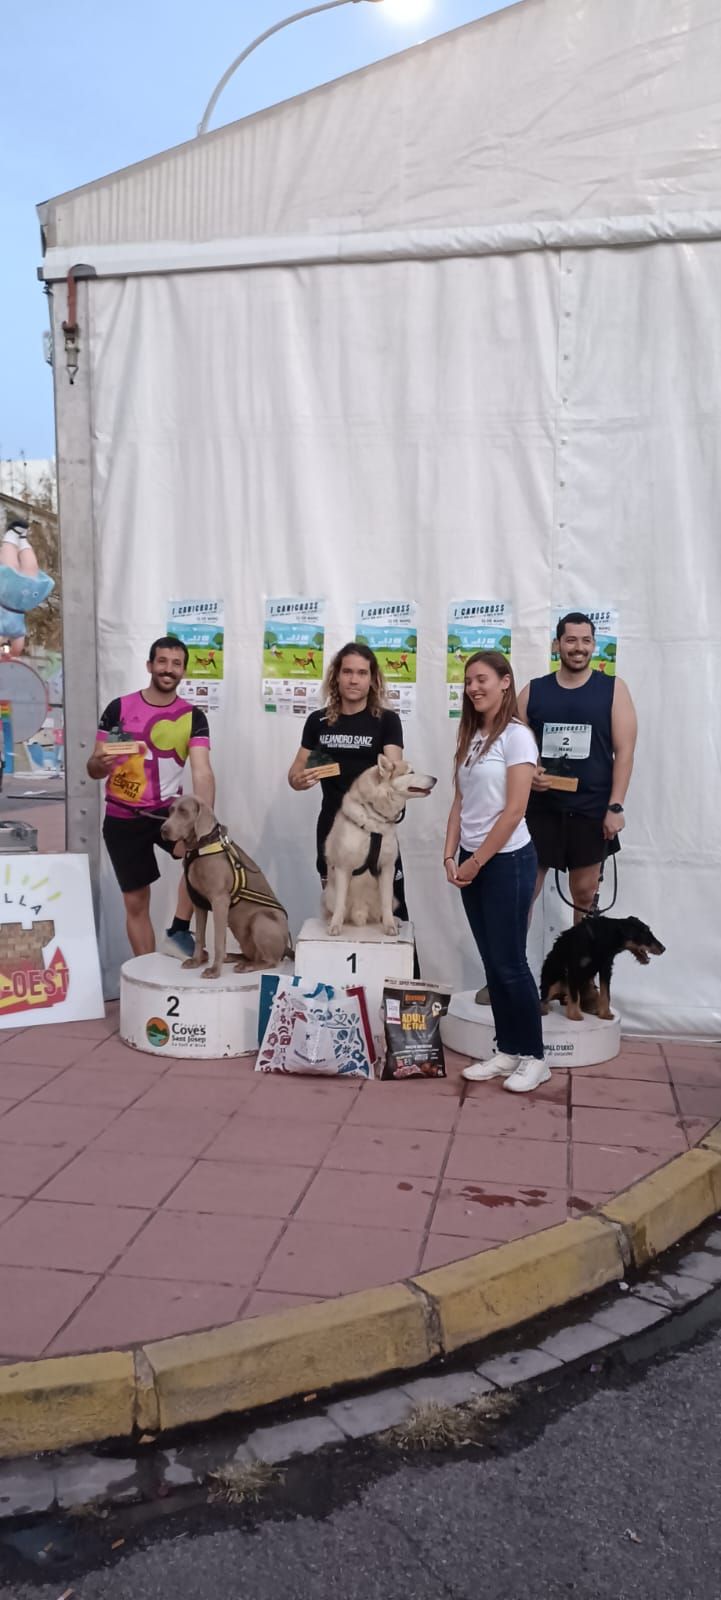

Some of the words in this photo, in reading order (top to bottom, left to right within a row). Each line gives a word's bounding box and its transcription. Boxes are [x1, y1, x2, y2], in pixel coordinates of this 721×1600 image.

[178, 603, 218, 614] CANICROSS
[276, 602, 319, 613] CANICROSS
[367, 604, 410, 617] CANICROSS
[461, 604, 505, 616] CANICROSS
[319, 734, 353, 745] ALEJANDRO
[353, 736, 373, 746] SANZ
[562, 737, 570, 746] 2
[346, 952, 357, 974] 1
[166, 995, 180, 1017] 2
[402, 1013, 426, 1024] ADULT
[172, 1023, 206, 1036] Coves
